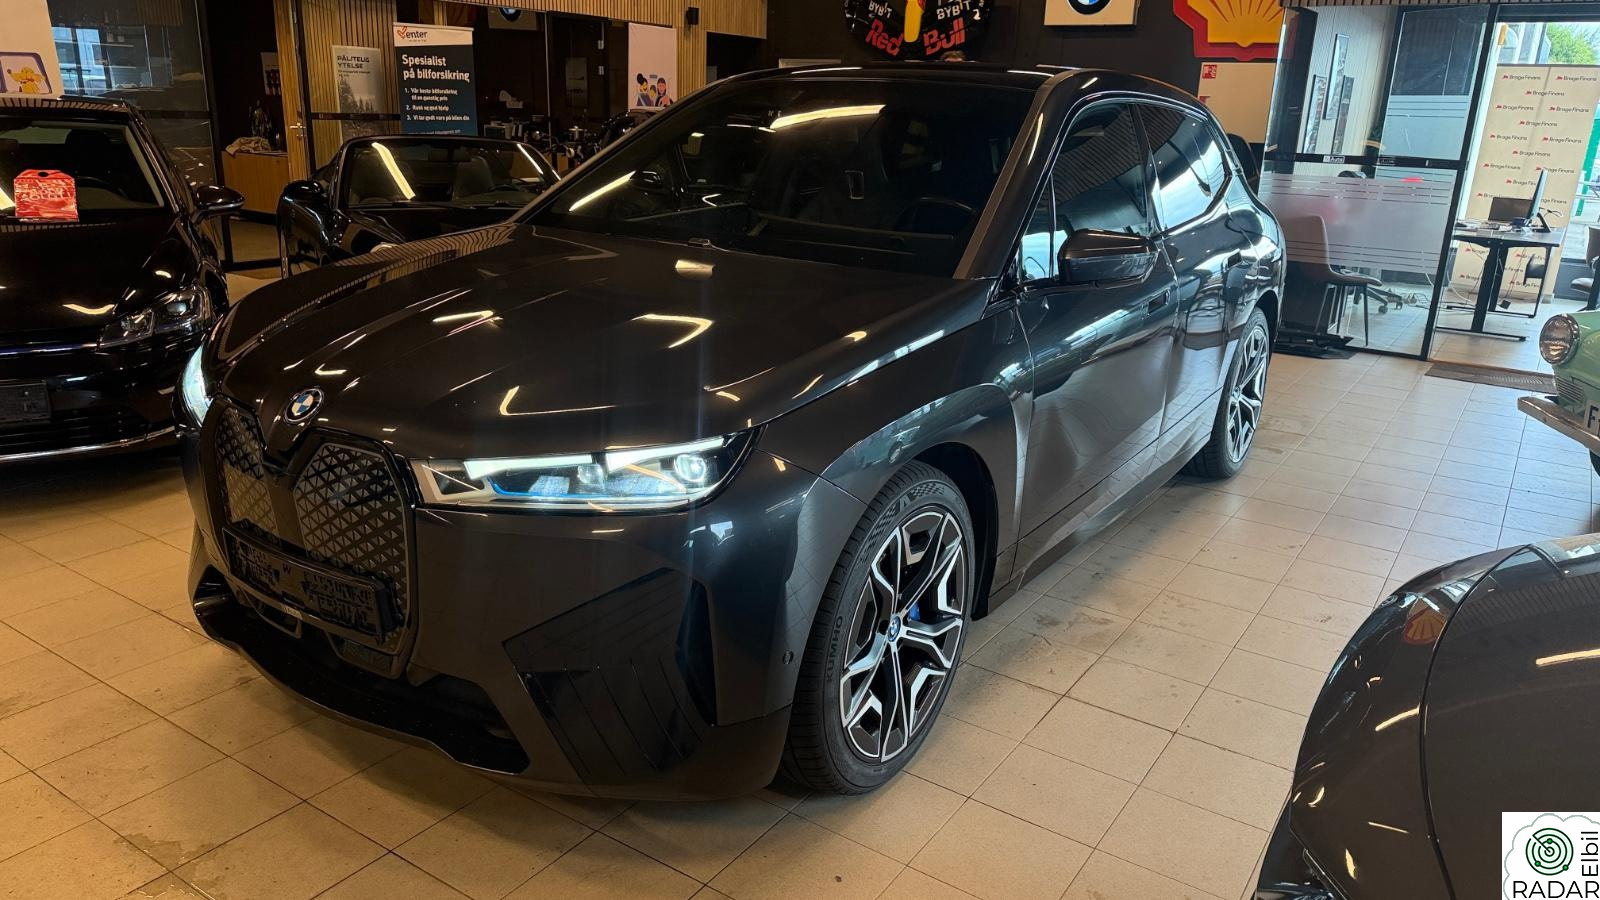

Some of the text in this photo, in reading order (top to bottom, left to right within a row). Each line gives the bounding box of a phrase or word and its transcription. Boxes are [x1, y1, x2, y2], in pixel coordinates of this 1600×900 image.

[868, 1, 892, 18] BYBIT
[936, 1, 970, 20] BYBIT
[866, 17, 966, 56] Red Bull
[402, 54, 447, 67] Spesialist
[403, 67, 470, 83] på bilforsikring
[827, 615, 843, 682] KUMHO
